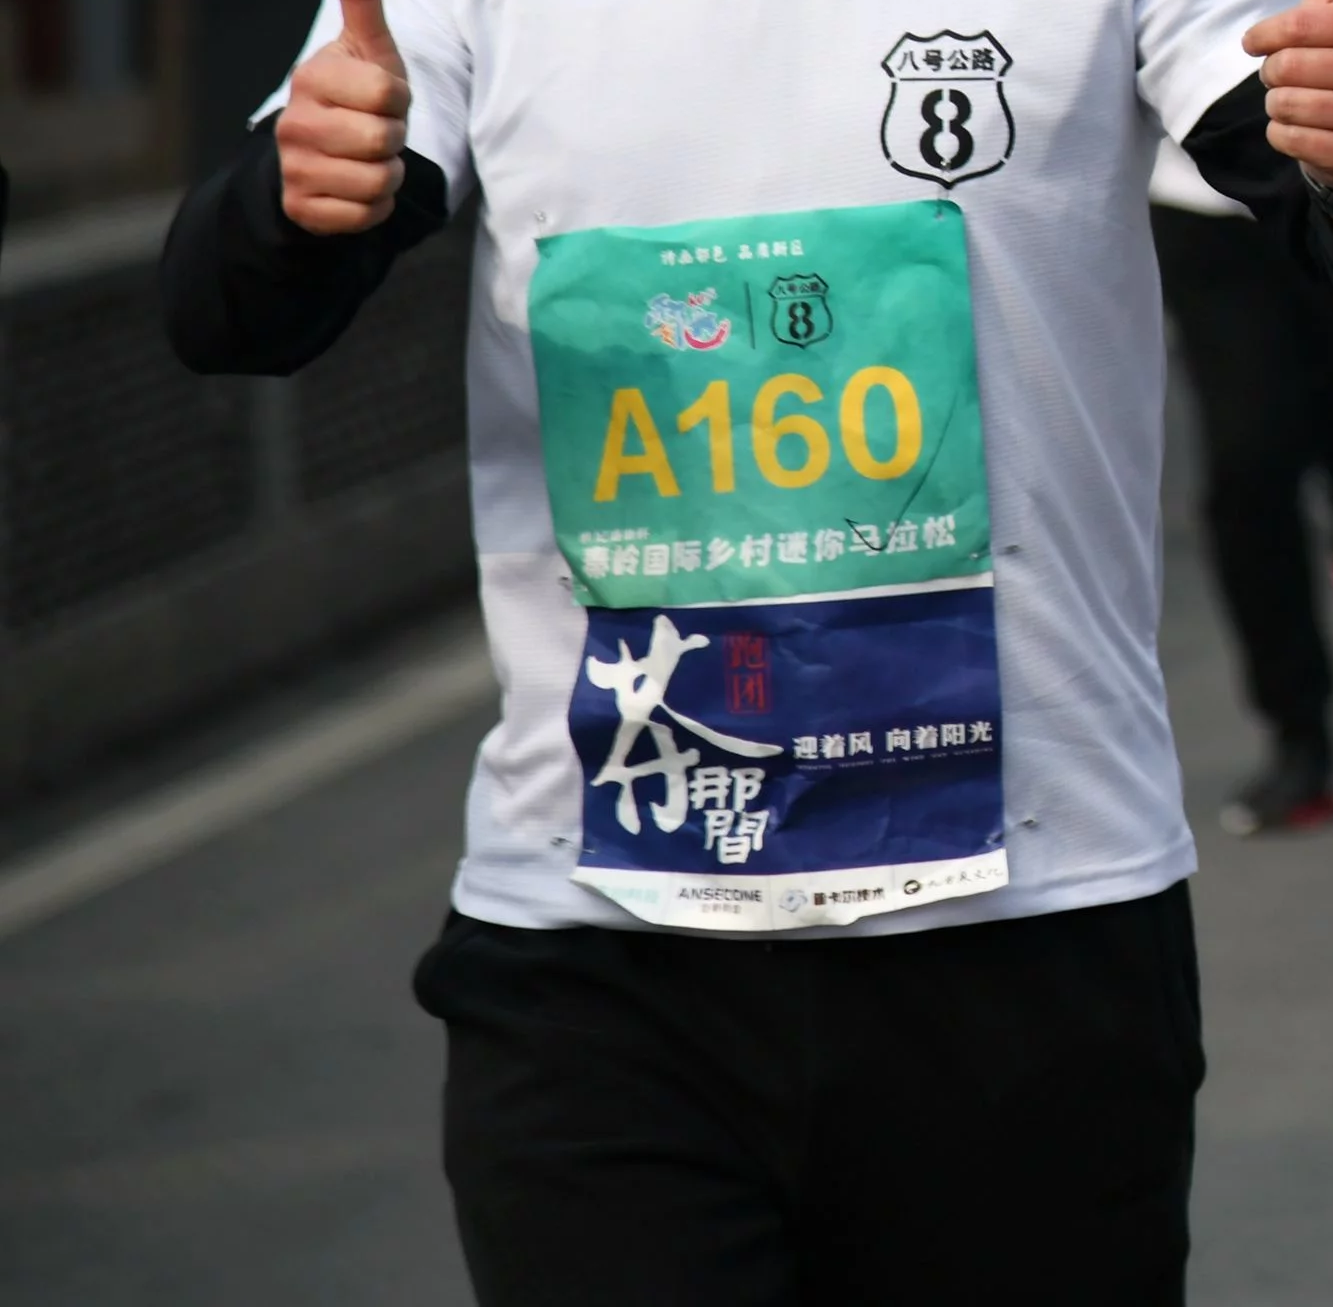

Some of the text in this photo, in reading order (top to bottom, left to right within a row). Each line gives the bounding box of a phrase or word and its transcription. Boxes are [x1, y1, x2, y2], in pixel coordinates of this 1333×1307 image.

[897, 47, 996, 72] 八号公路
[919, 88, 974, 171] 8
[788, 301, 814, 340] 8
[593, 365, 923, 502] A160
[582, 514, 957, 579] 秦岭国际乡村迷你马拉松
[793, 731, 873, 760] 迎着风
[886, 721, 993, 752] 向着阳光
